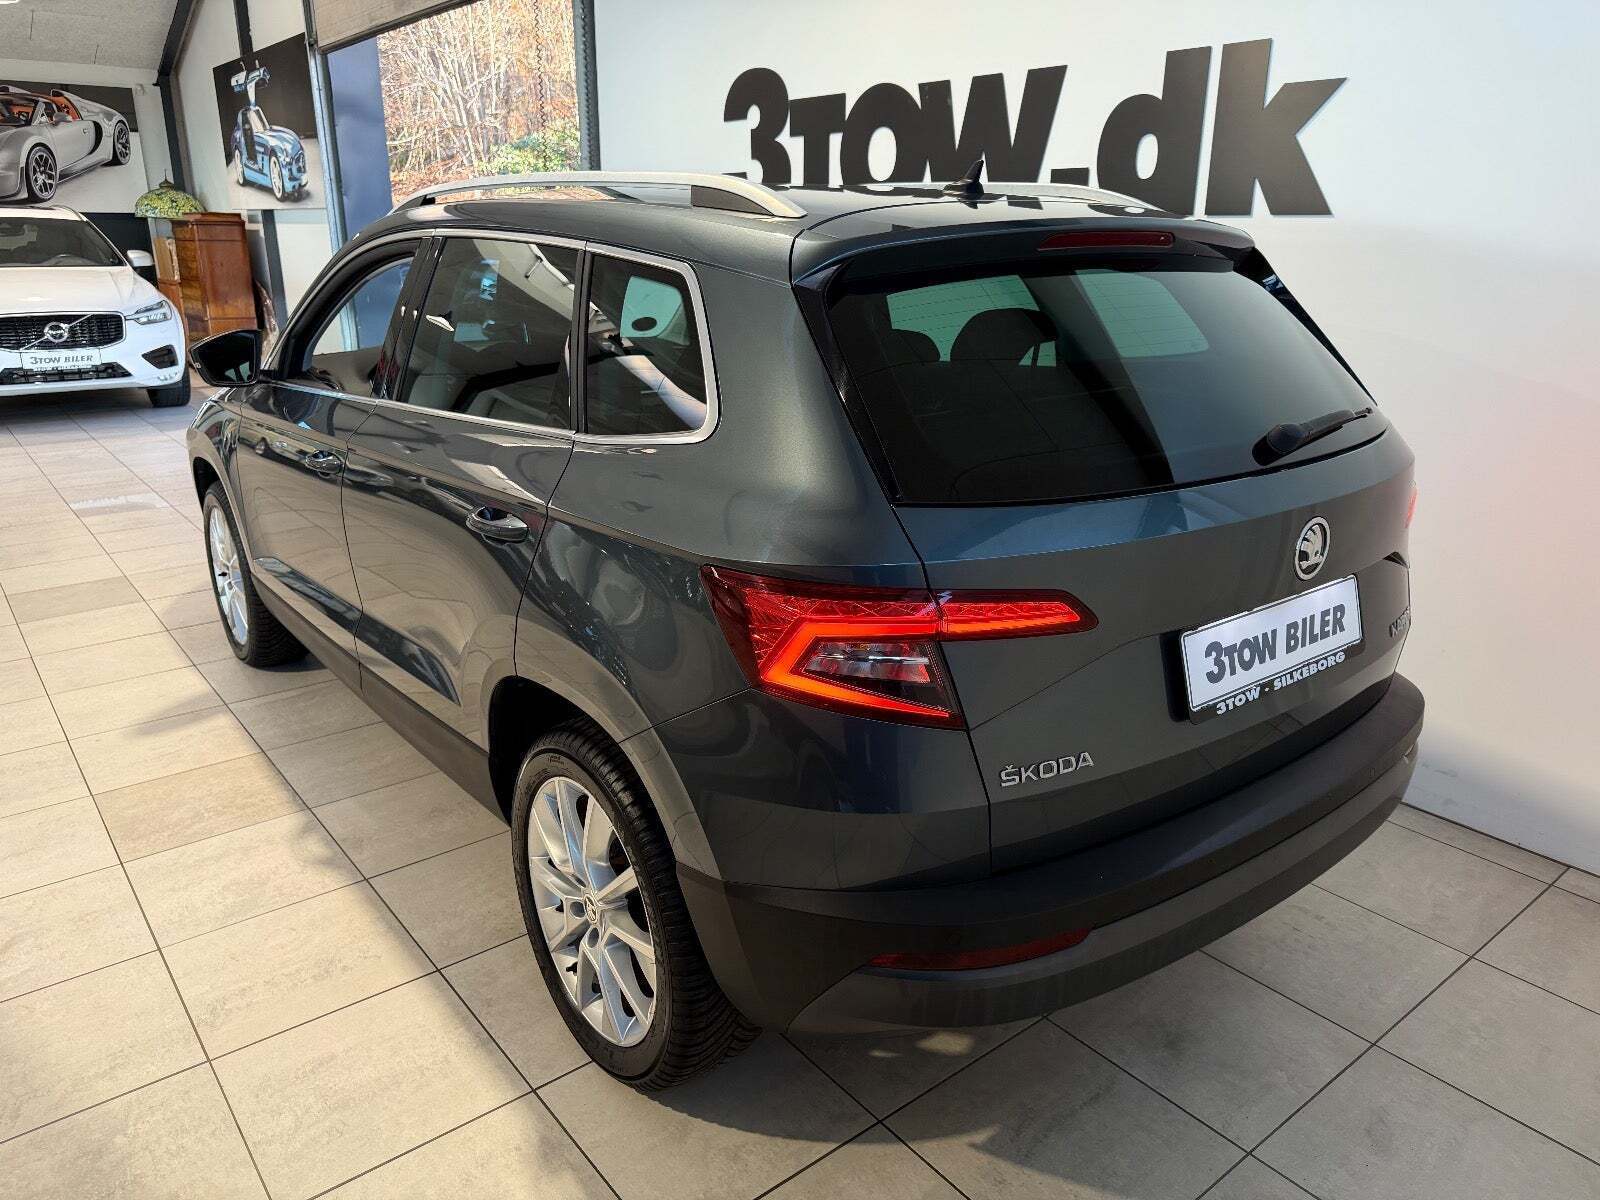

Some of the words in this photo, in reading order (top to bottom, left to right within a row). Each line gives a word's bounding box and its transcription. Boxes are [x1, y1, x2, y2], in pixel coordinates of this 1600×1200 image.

[1204, 628, 1278, 685] 3TOW
[1285, 603, 1346, 655] BILER
[1216, 686, 1261, 715] 3TOW
[1273, 651, 1346, 691] SILKEBORG
[1000, 751, 1095, 787] ŠKODA
